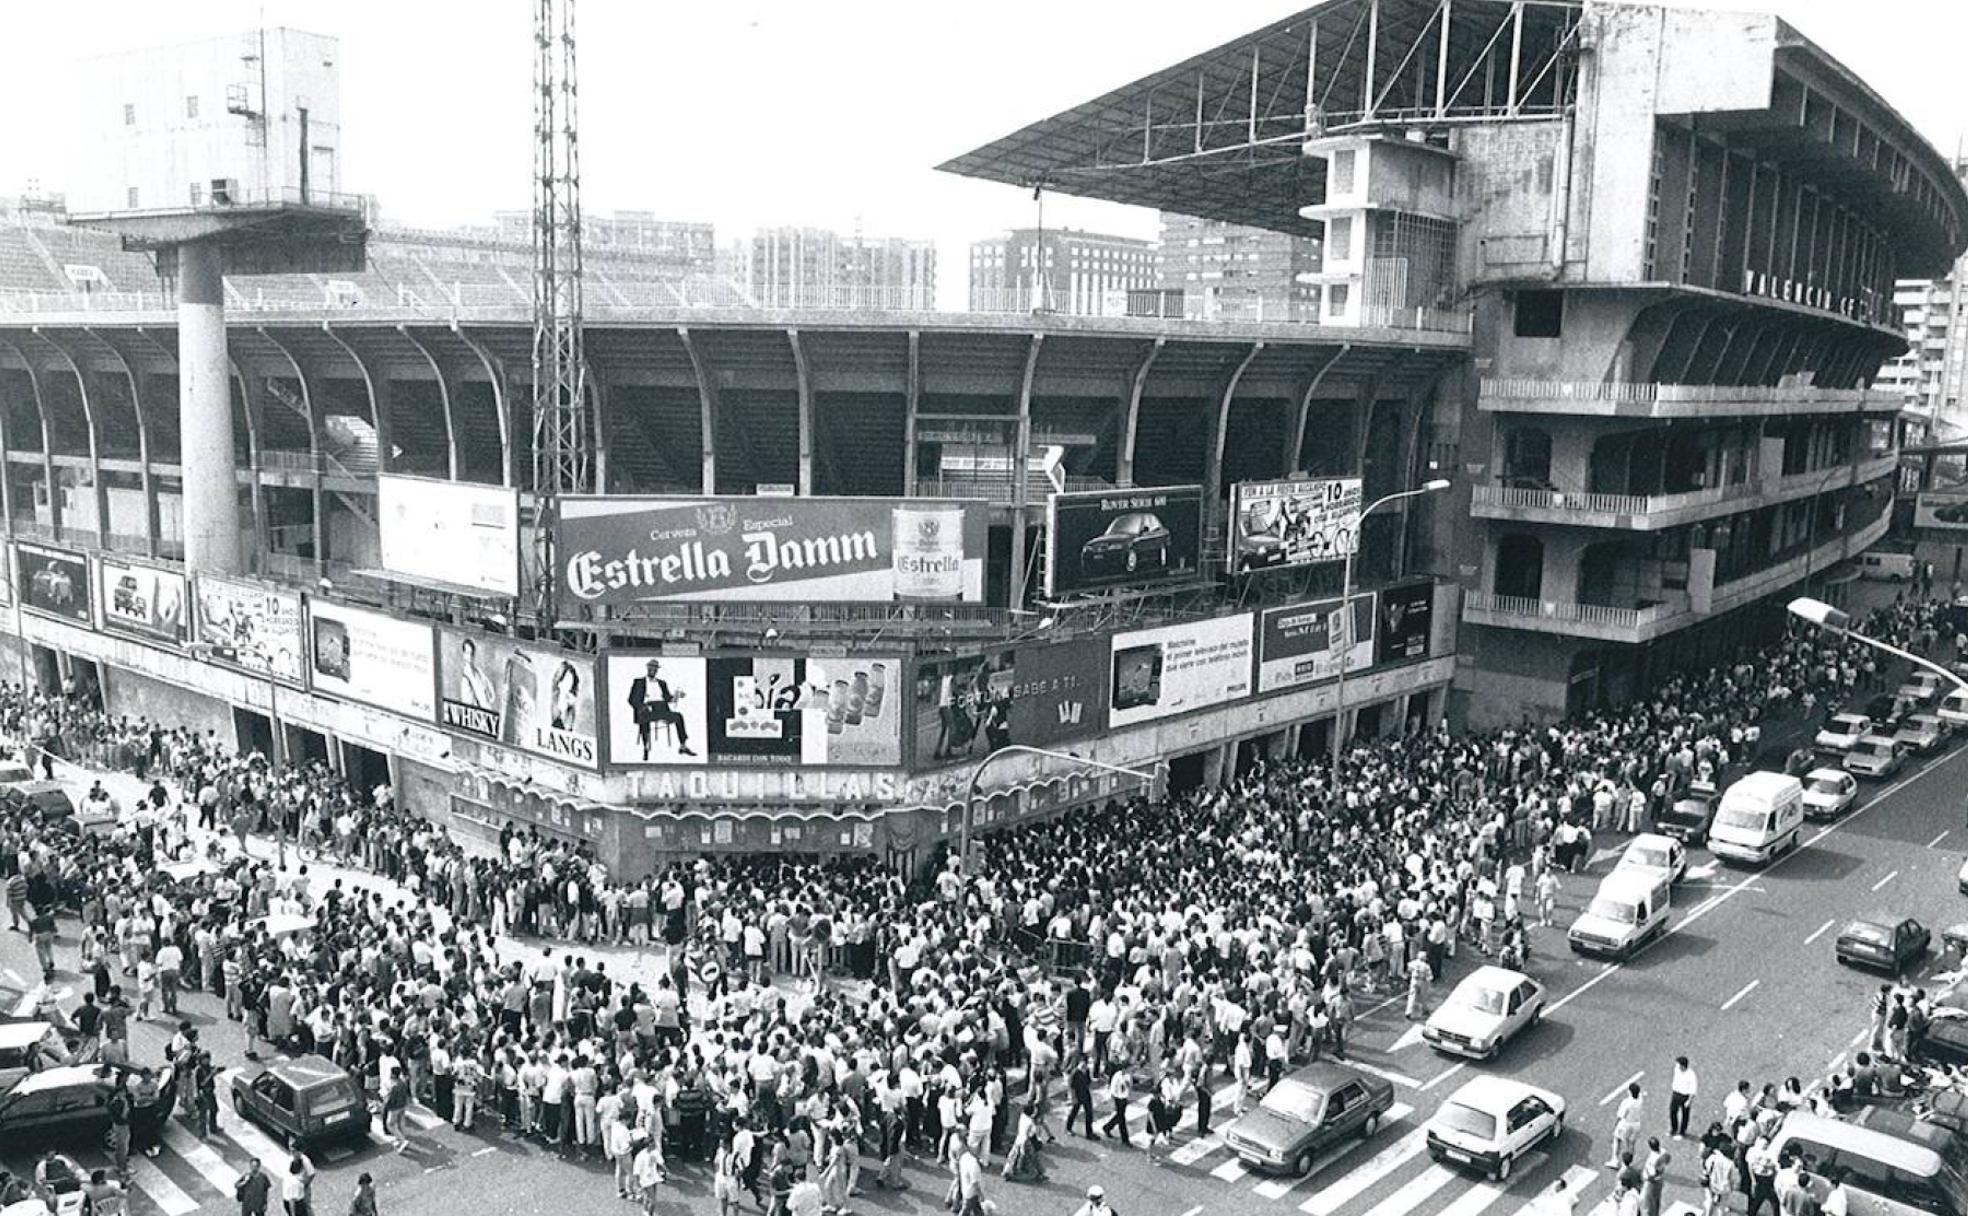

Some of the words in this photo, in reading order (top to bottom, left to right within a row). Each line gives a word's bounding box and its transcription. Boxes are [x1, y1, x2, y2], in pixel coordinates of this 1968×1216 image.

[1745, 269, 1832, 310] VALENCIA
[1328, 483, 1342, 502] 10
[743, 515, 794, 532] Especial
[650, 528, 698, 541] Cerveza
[567, 541, 732, 599] Estrella
[742, 530, 877, 582] Damm
[897, 555, 960, 575] Estrella
[1013, 680, 1047, 699] SABE
[536, 727, 592, 761] LANGS
[626, 770, 895, 801] TAQUILLAS
